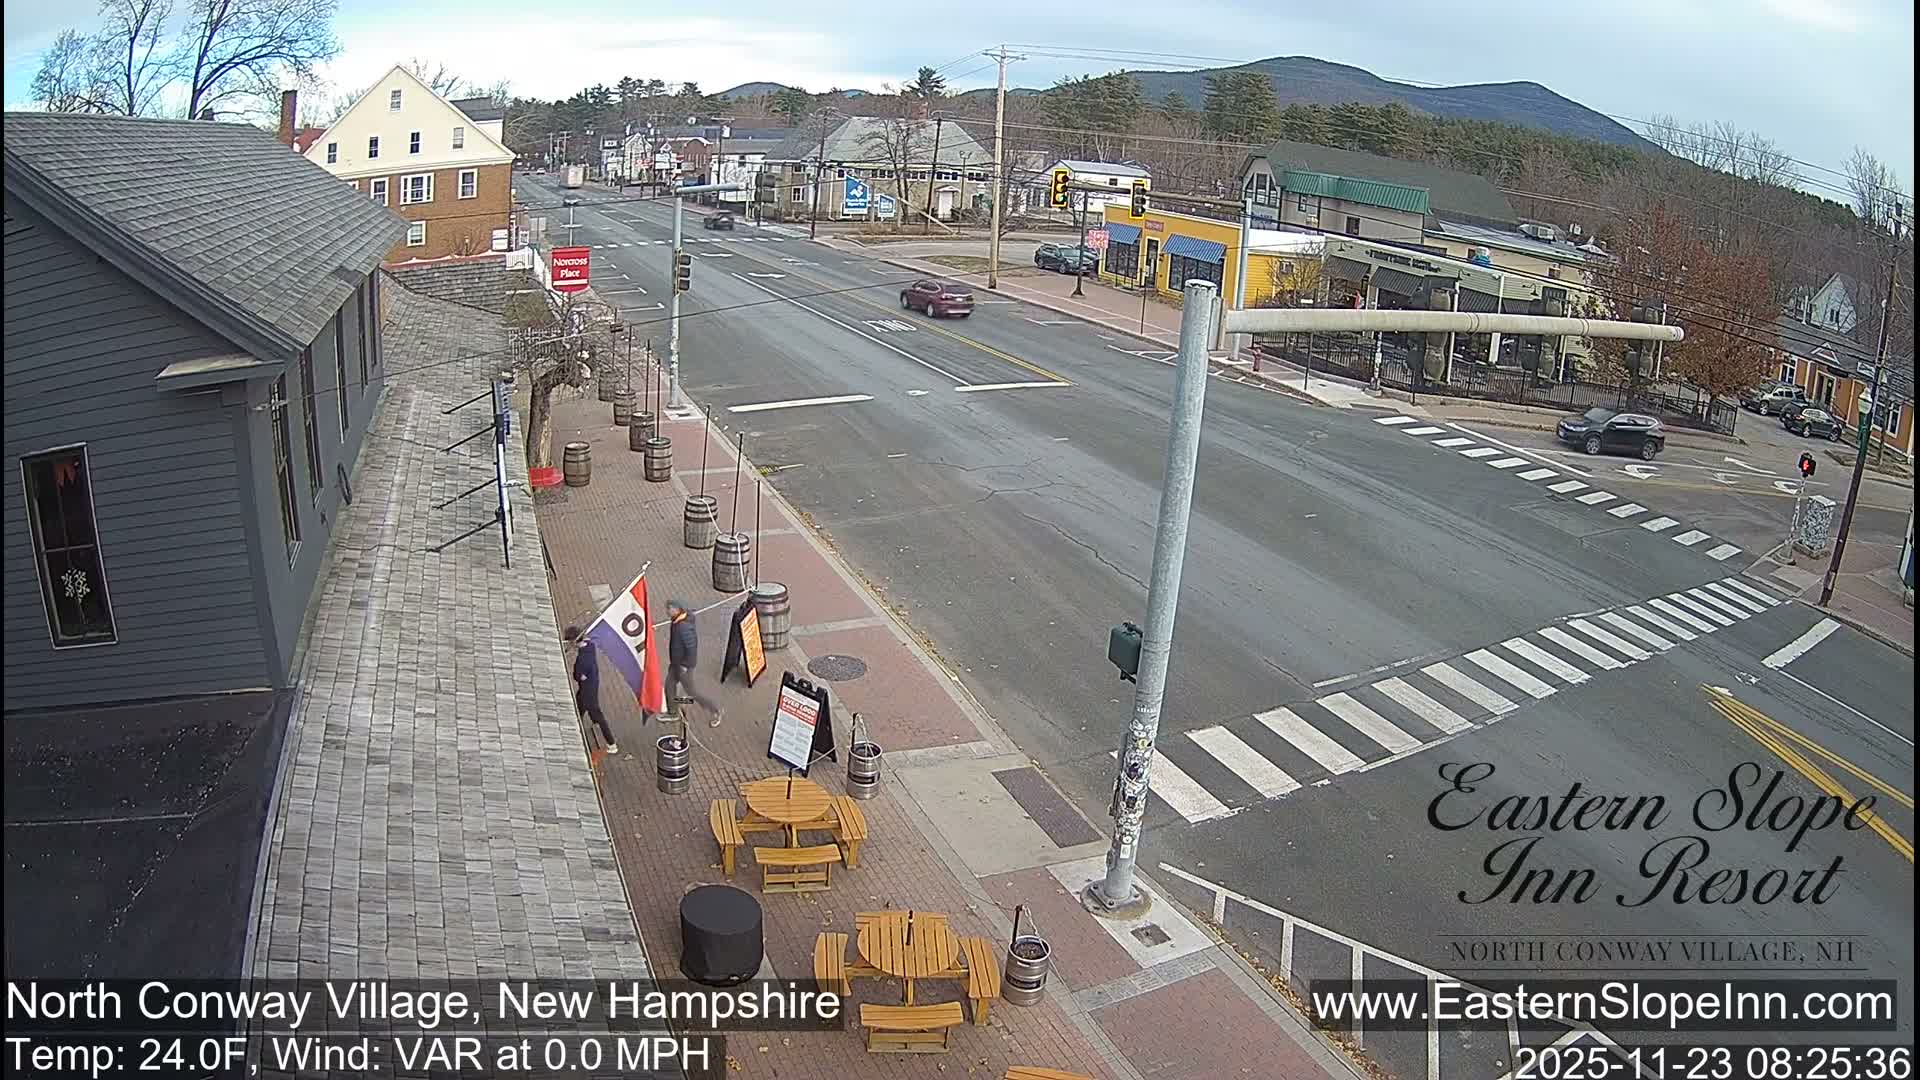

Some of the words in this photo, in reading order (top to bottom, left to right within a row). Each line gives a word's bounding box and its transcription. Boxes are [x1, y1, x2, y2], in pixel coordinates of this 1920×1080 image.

[553, 257, 588, 267] Norcross
[559, 268, 580, 278] Place
[861, 319, 918, 333] ONLY
